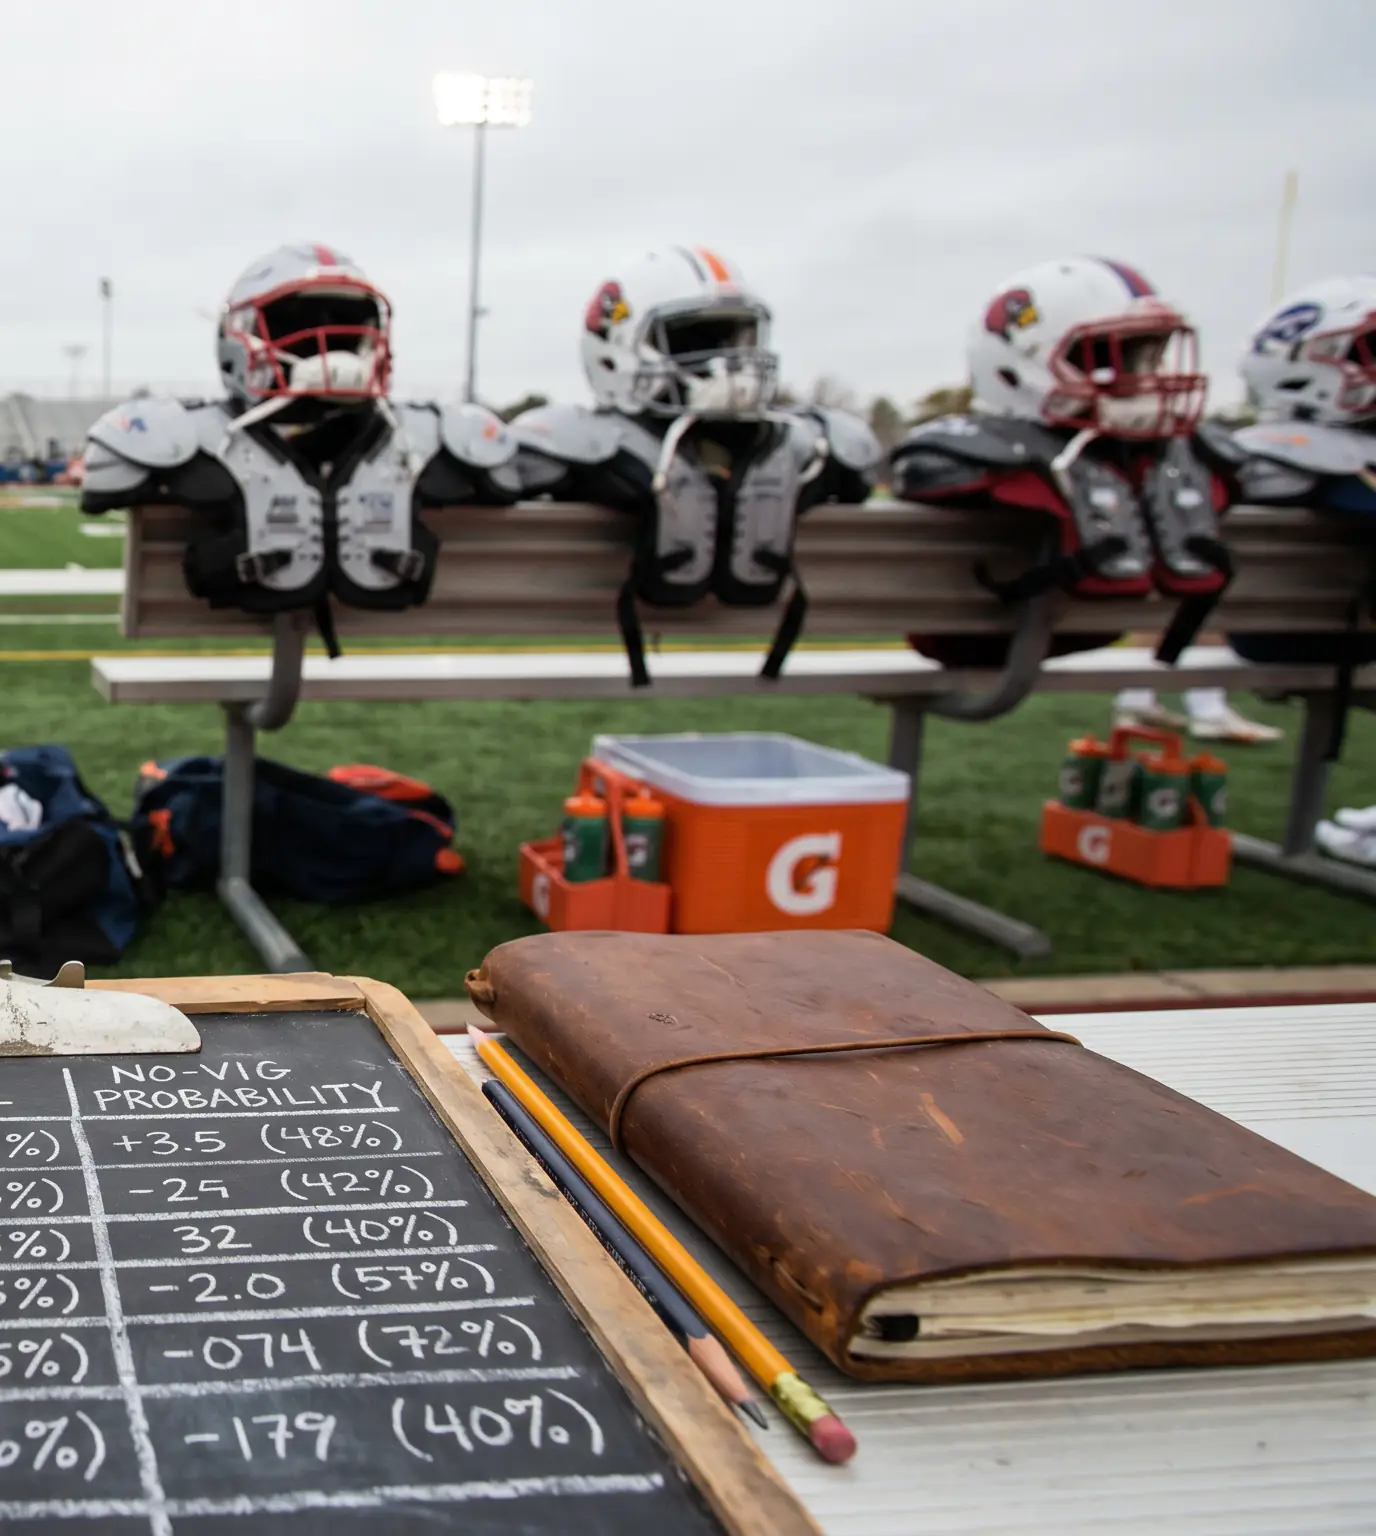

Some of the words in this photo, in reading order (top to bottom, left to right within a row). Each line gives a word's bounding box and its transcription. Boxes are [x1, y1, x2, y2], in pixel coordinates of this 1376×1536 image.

[1077, 824, 1112, 864] G
[766, 832, 842, 916] G
[112, 1060, 292, 1086] NO-VIG
[93, 1081, 385, 1112] PROBABILITY
[113, 1131, 226, 1155] +3.5
[261, 1120, 404, 1154] (48%)
[281, 1165, 434, 1200] (42%)
[173, 1225, 252, 1254] 32
[303, 1213, 459, 1247] (40%)
[149, 1273, 286, 1303] -2.0
[331, 1257, 495, 1299] (57%)
[358, 1314, 542, 1367] (72%)
[184, 1411, 337, 1462] -179
[392, 1388, 604, 1462] (40%)
